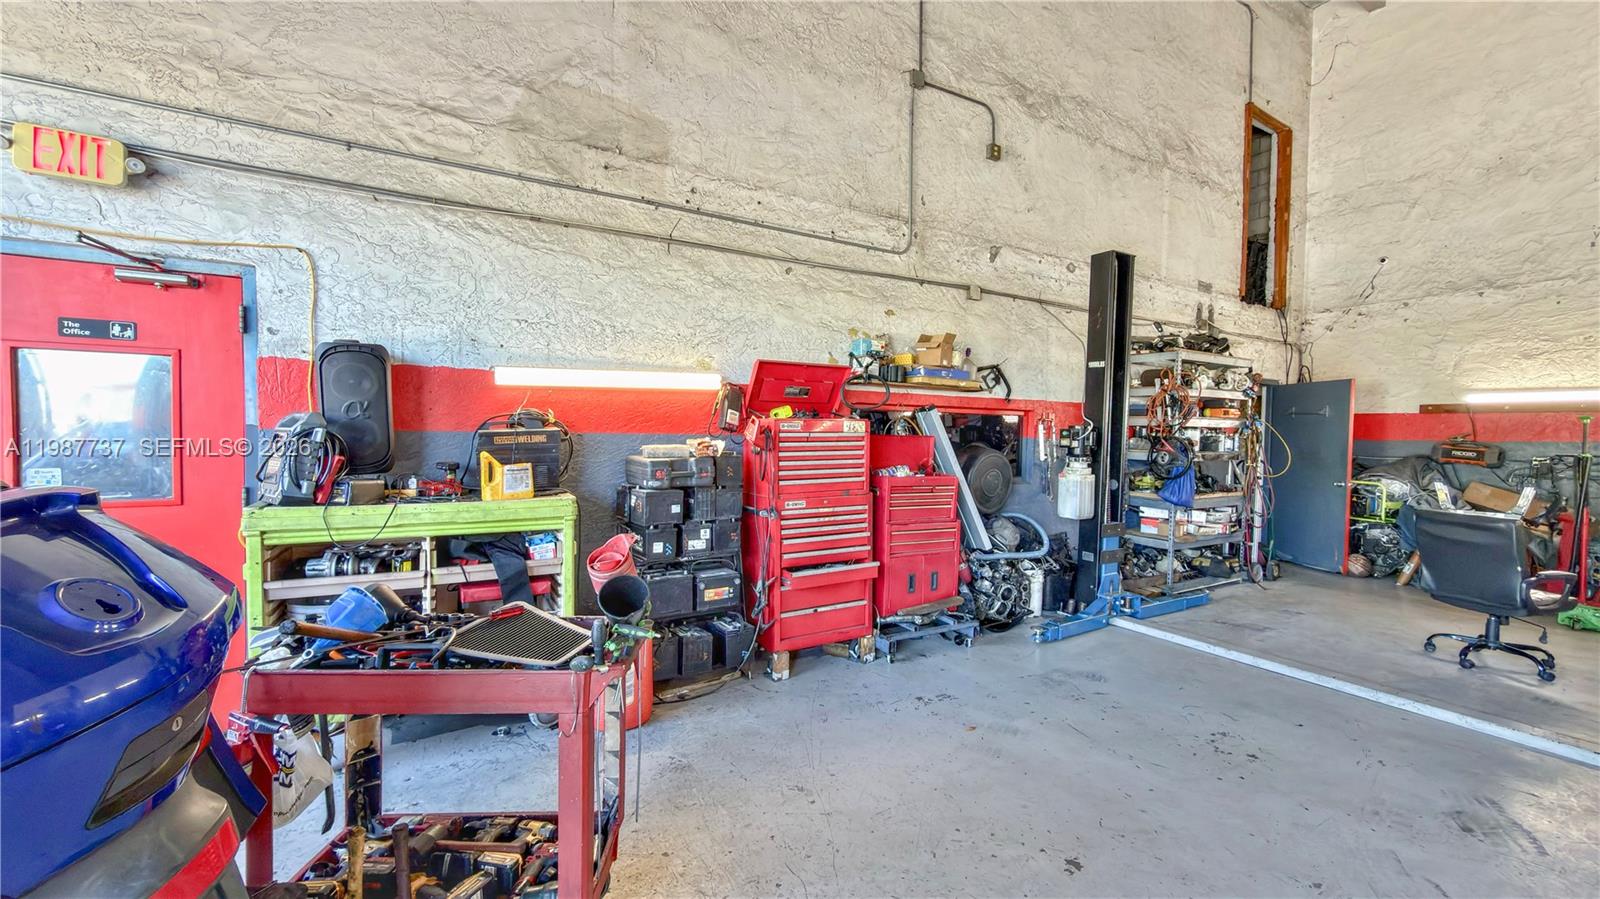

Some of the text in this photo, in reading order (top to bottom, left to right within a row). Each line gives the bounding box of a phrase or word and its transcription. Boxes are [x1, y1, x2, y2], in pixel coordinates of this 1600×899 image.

[32, 126, 112, 180] EXIT
[62, 320, 81, 328] The
[62, 328, 91, 336] Office
[517, 434, 547, 443] WELDING
